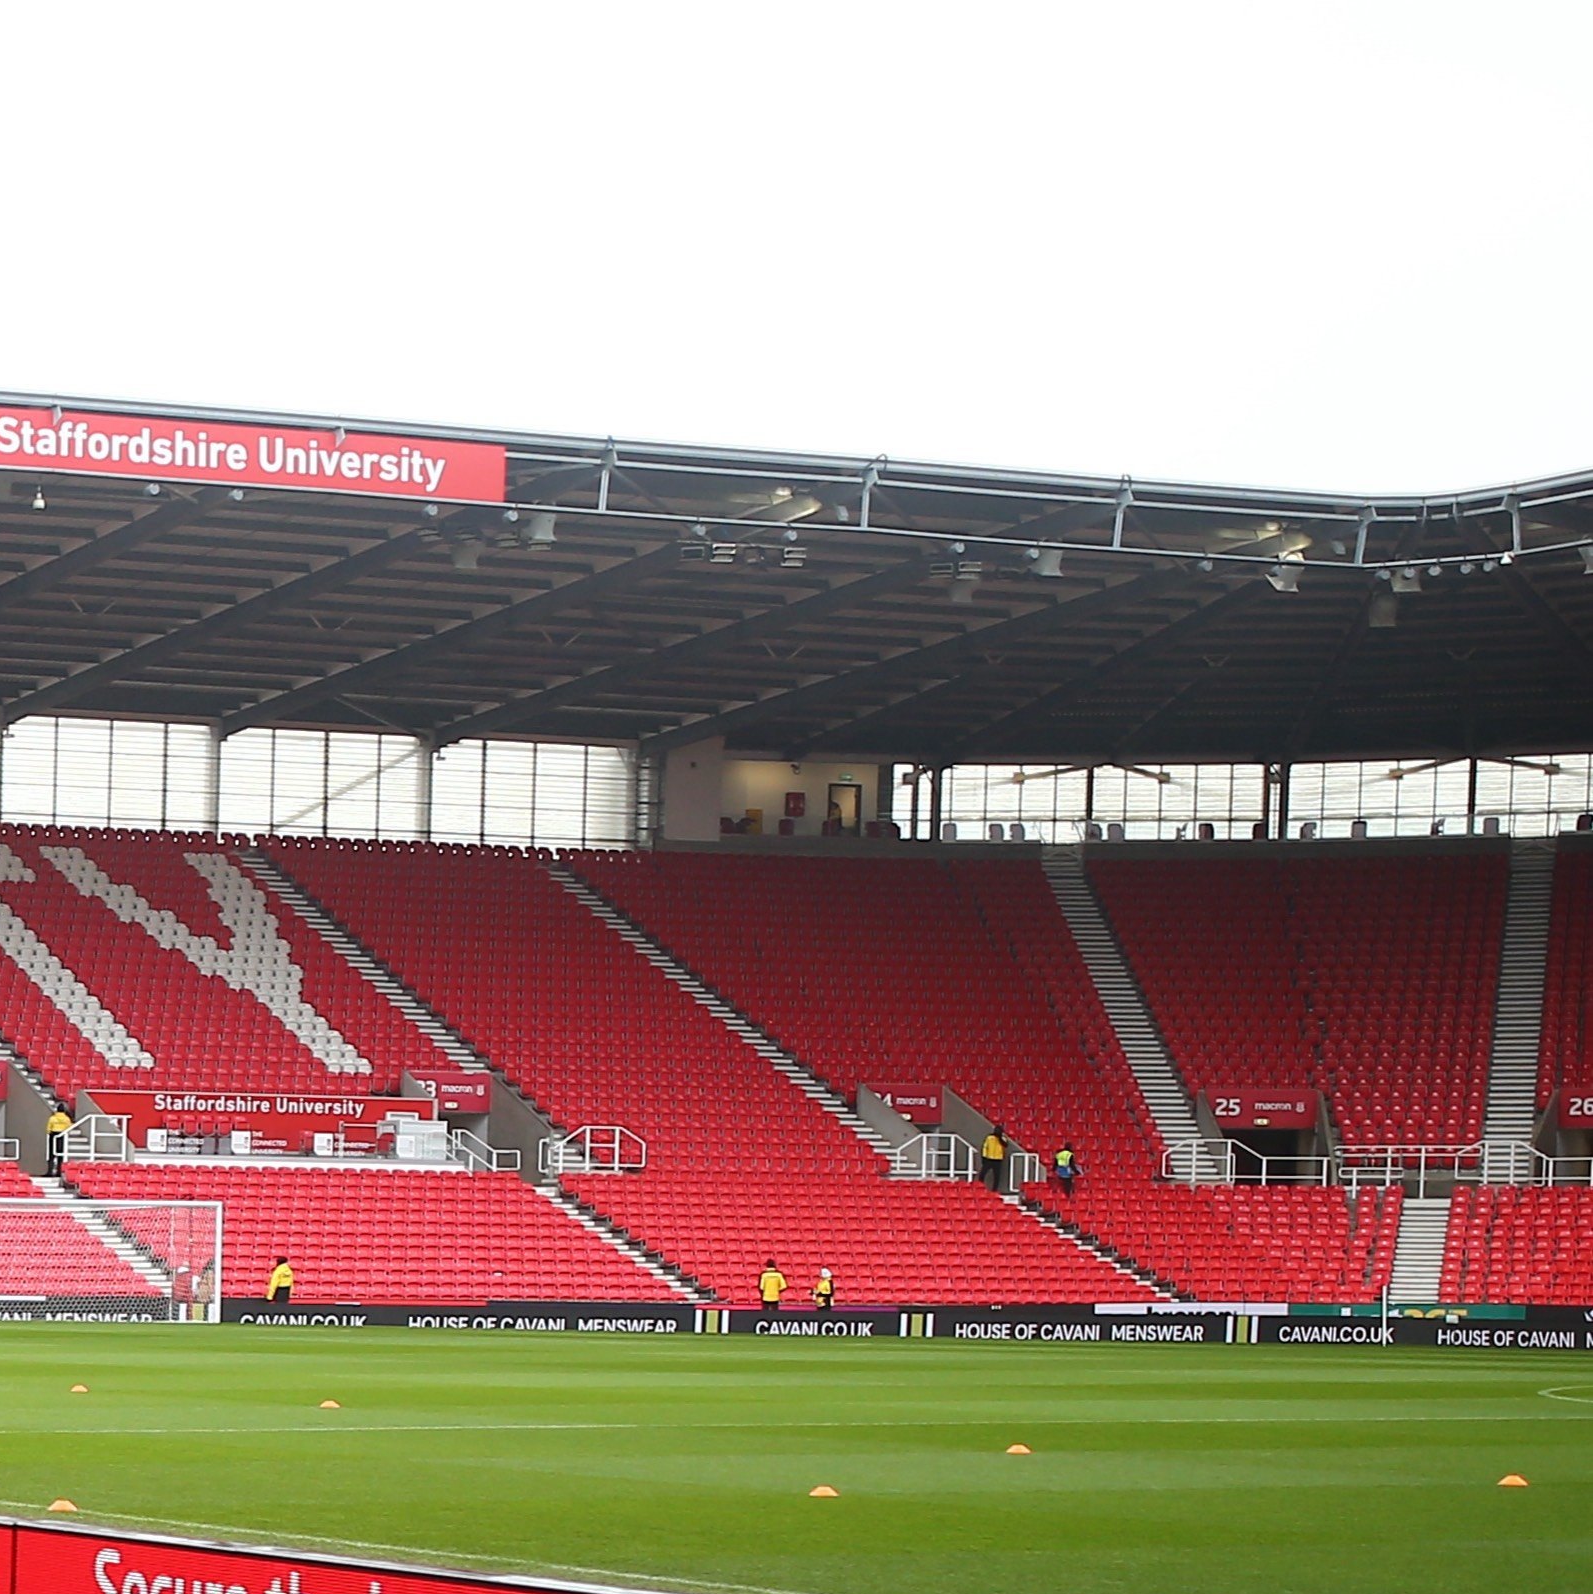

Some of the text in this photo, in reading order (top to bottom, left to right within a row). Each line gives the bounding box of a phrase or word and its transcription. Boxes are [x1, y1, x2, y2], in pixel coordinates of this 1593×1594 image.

[256, 436, 448, 493] University
[154, 1093, 365, 1118] Staffordshire University
[1215, 1098, 1292, 1117] 25 macron
[1569, 1097, 1593, 1116] 26
[408, 1316, 678, 1333] HOUSE OF CAVANI MENSWEAR
[955, 1323, 1204, 1342] HOUSE OF CAVANI MENSWEAR
[1278, 1325, 1395, 1344] CAVANI.CO.UK
[1437, 1328, 1490, 1347] HOUSE
[1493, 1329, 1515, 1347] OF
[1517, 1330, 1575, 1348] CAVANI
